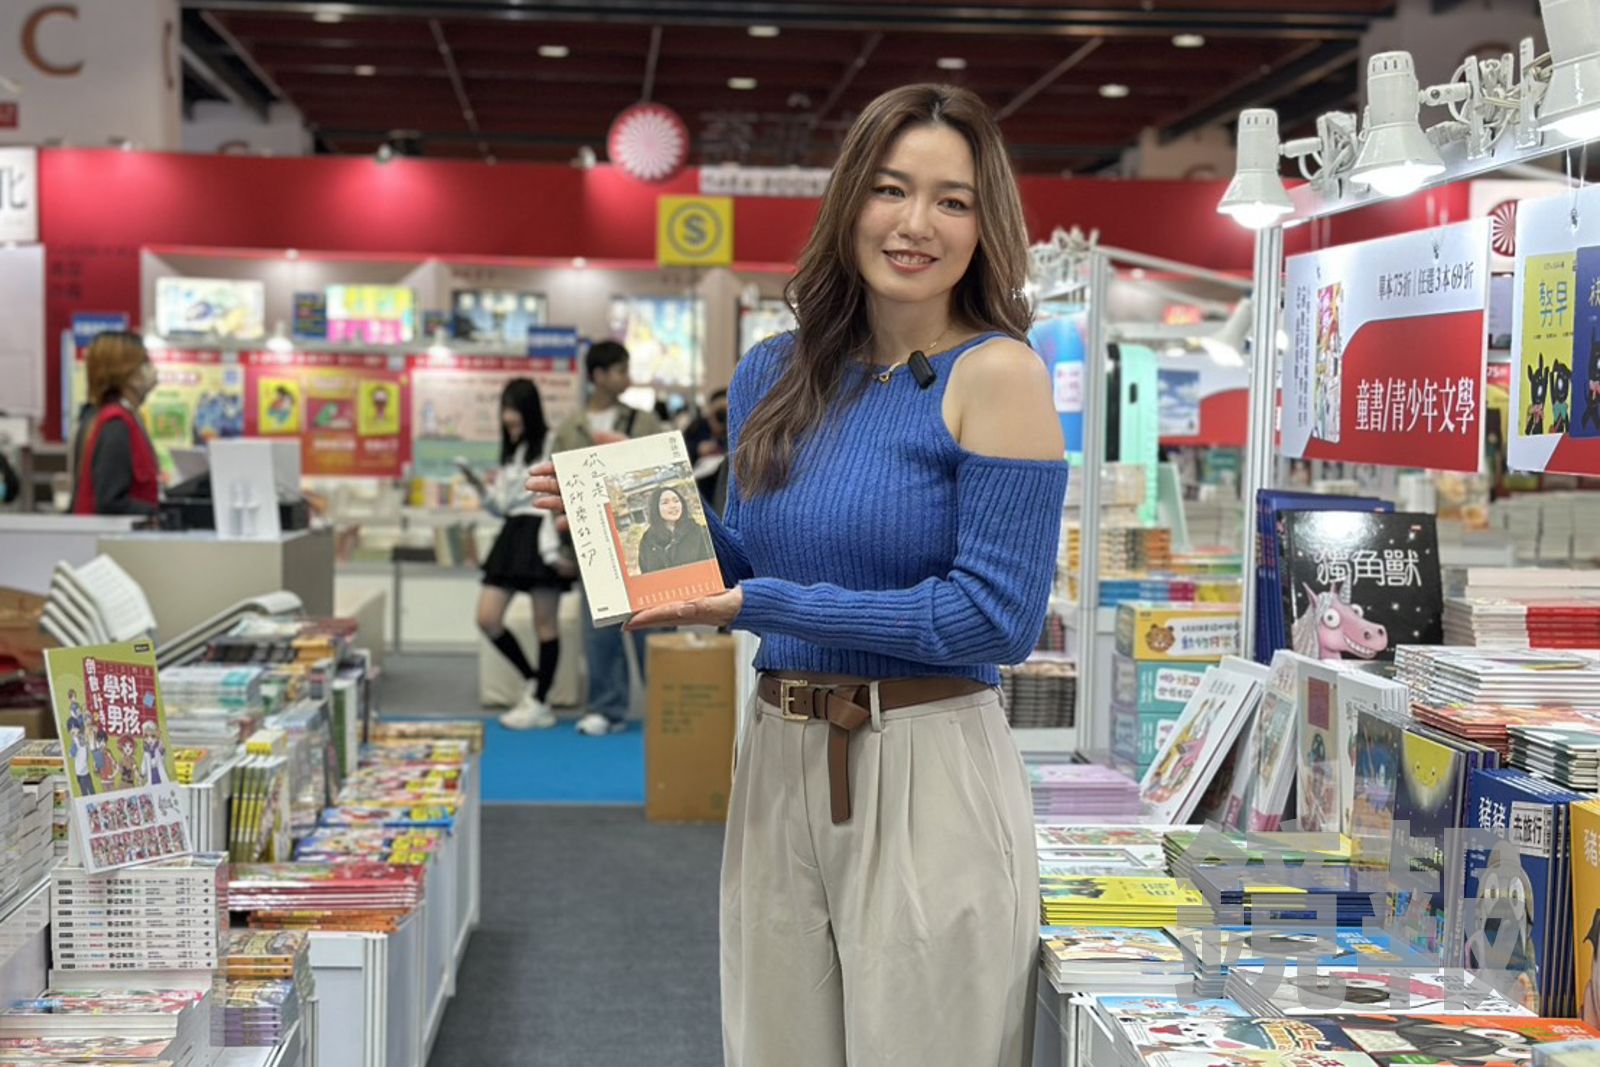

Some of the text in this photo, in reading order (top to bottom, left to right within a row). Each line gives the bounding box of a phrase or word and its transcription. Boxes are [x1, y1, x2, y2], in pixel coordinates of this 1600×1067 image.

[21, 5, 84, 77] C
[1355, 376, 1475, 435] 童書/青少年文學
[1313, 548, 1423, 587] 獨角獸
[103, 674, 138, 704] 學科
[107, 705, 141, 734] 男孩
